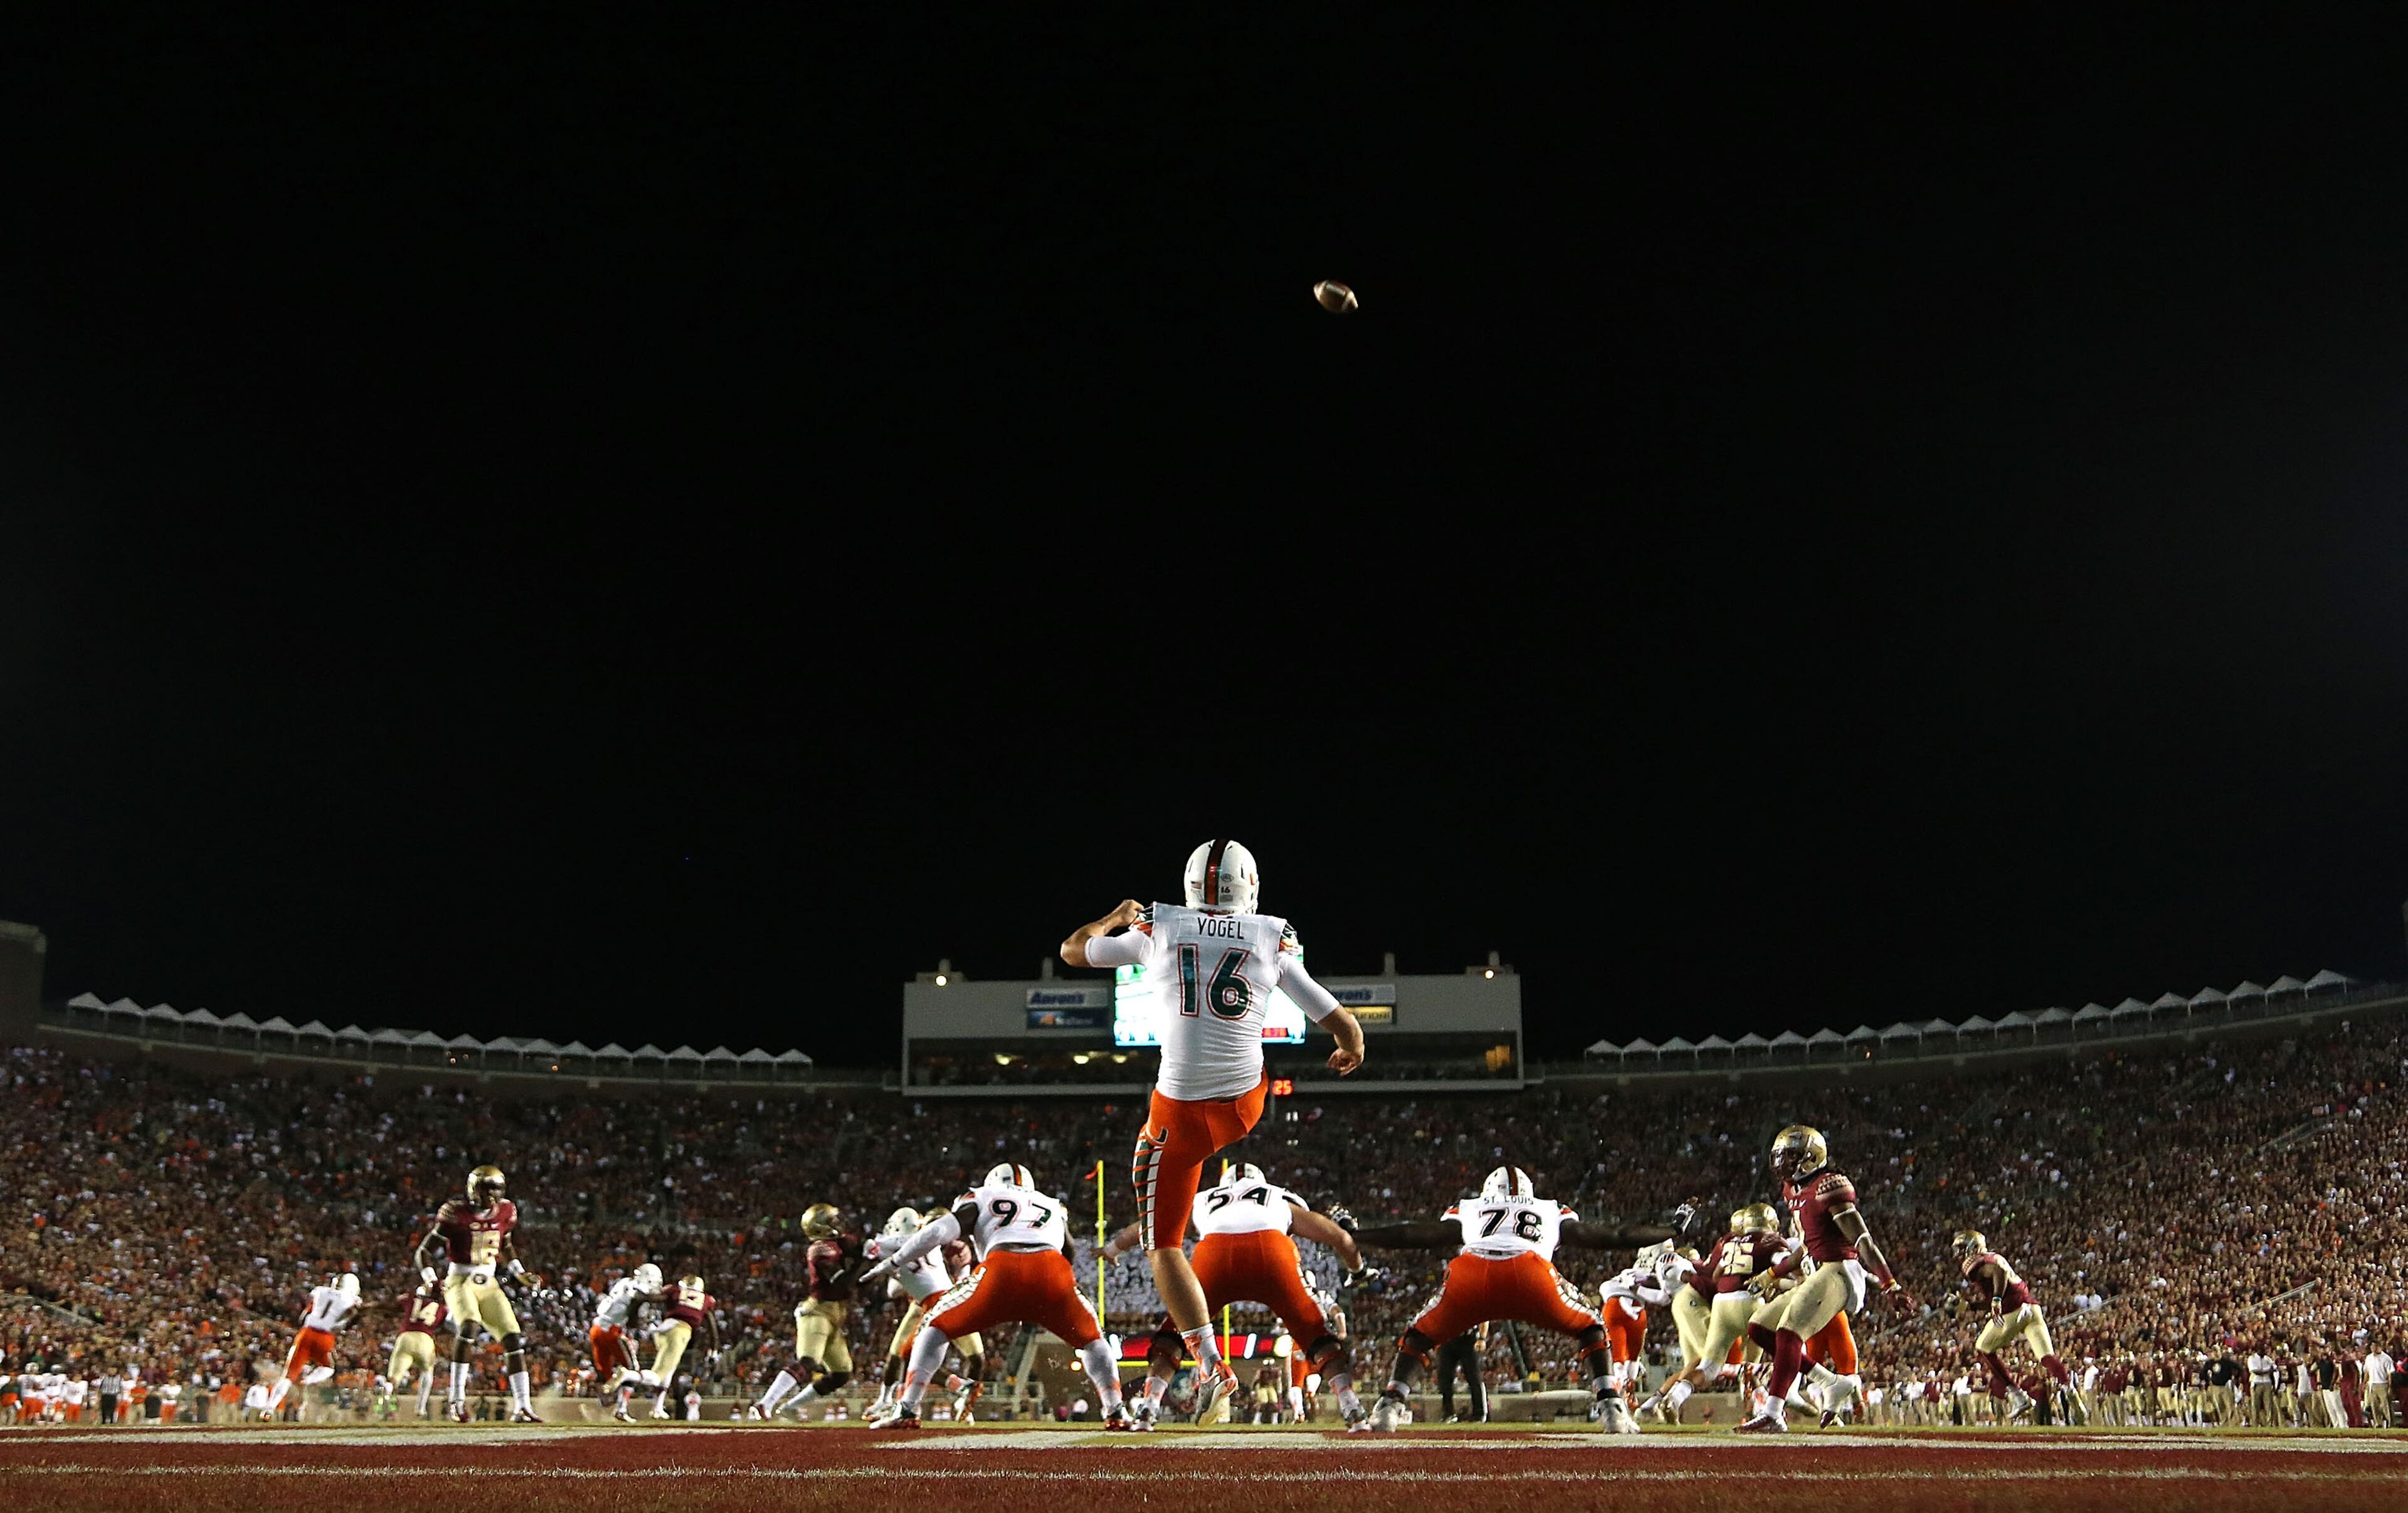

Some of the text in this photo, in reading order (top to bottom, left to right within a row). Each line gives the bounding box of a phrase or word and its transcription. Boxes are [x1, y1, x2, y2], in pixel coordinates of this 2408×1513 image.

[1177, 943, 1253, 1021] 16
[1272, 1080, 1293, 1095] 25
[988, 1196, 1053, 1229] 97
[1205, 1184, 1272, 1218] 54
[1478, 1206, 1543, 1243] 78
[320, 1299, 334, 1319] 1
[409, 1297, 440, 1327] 14
